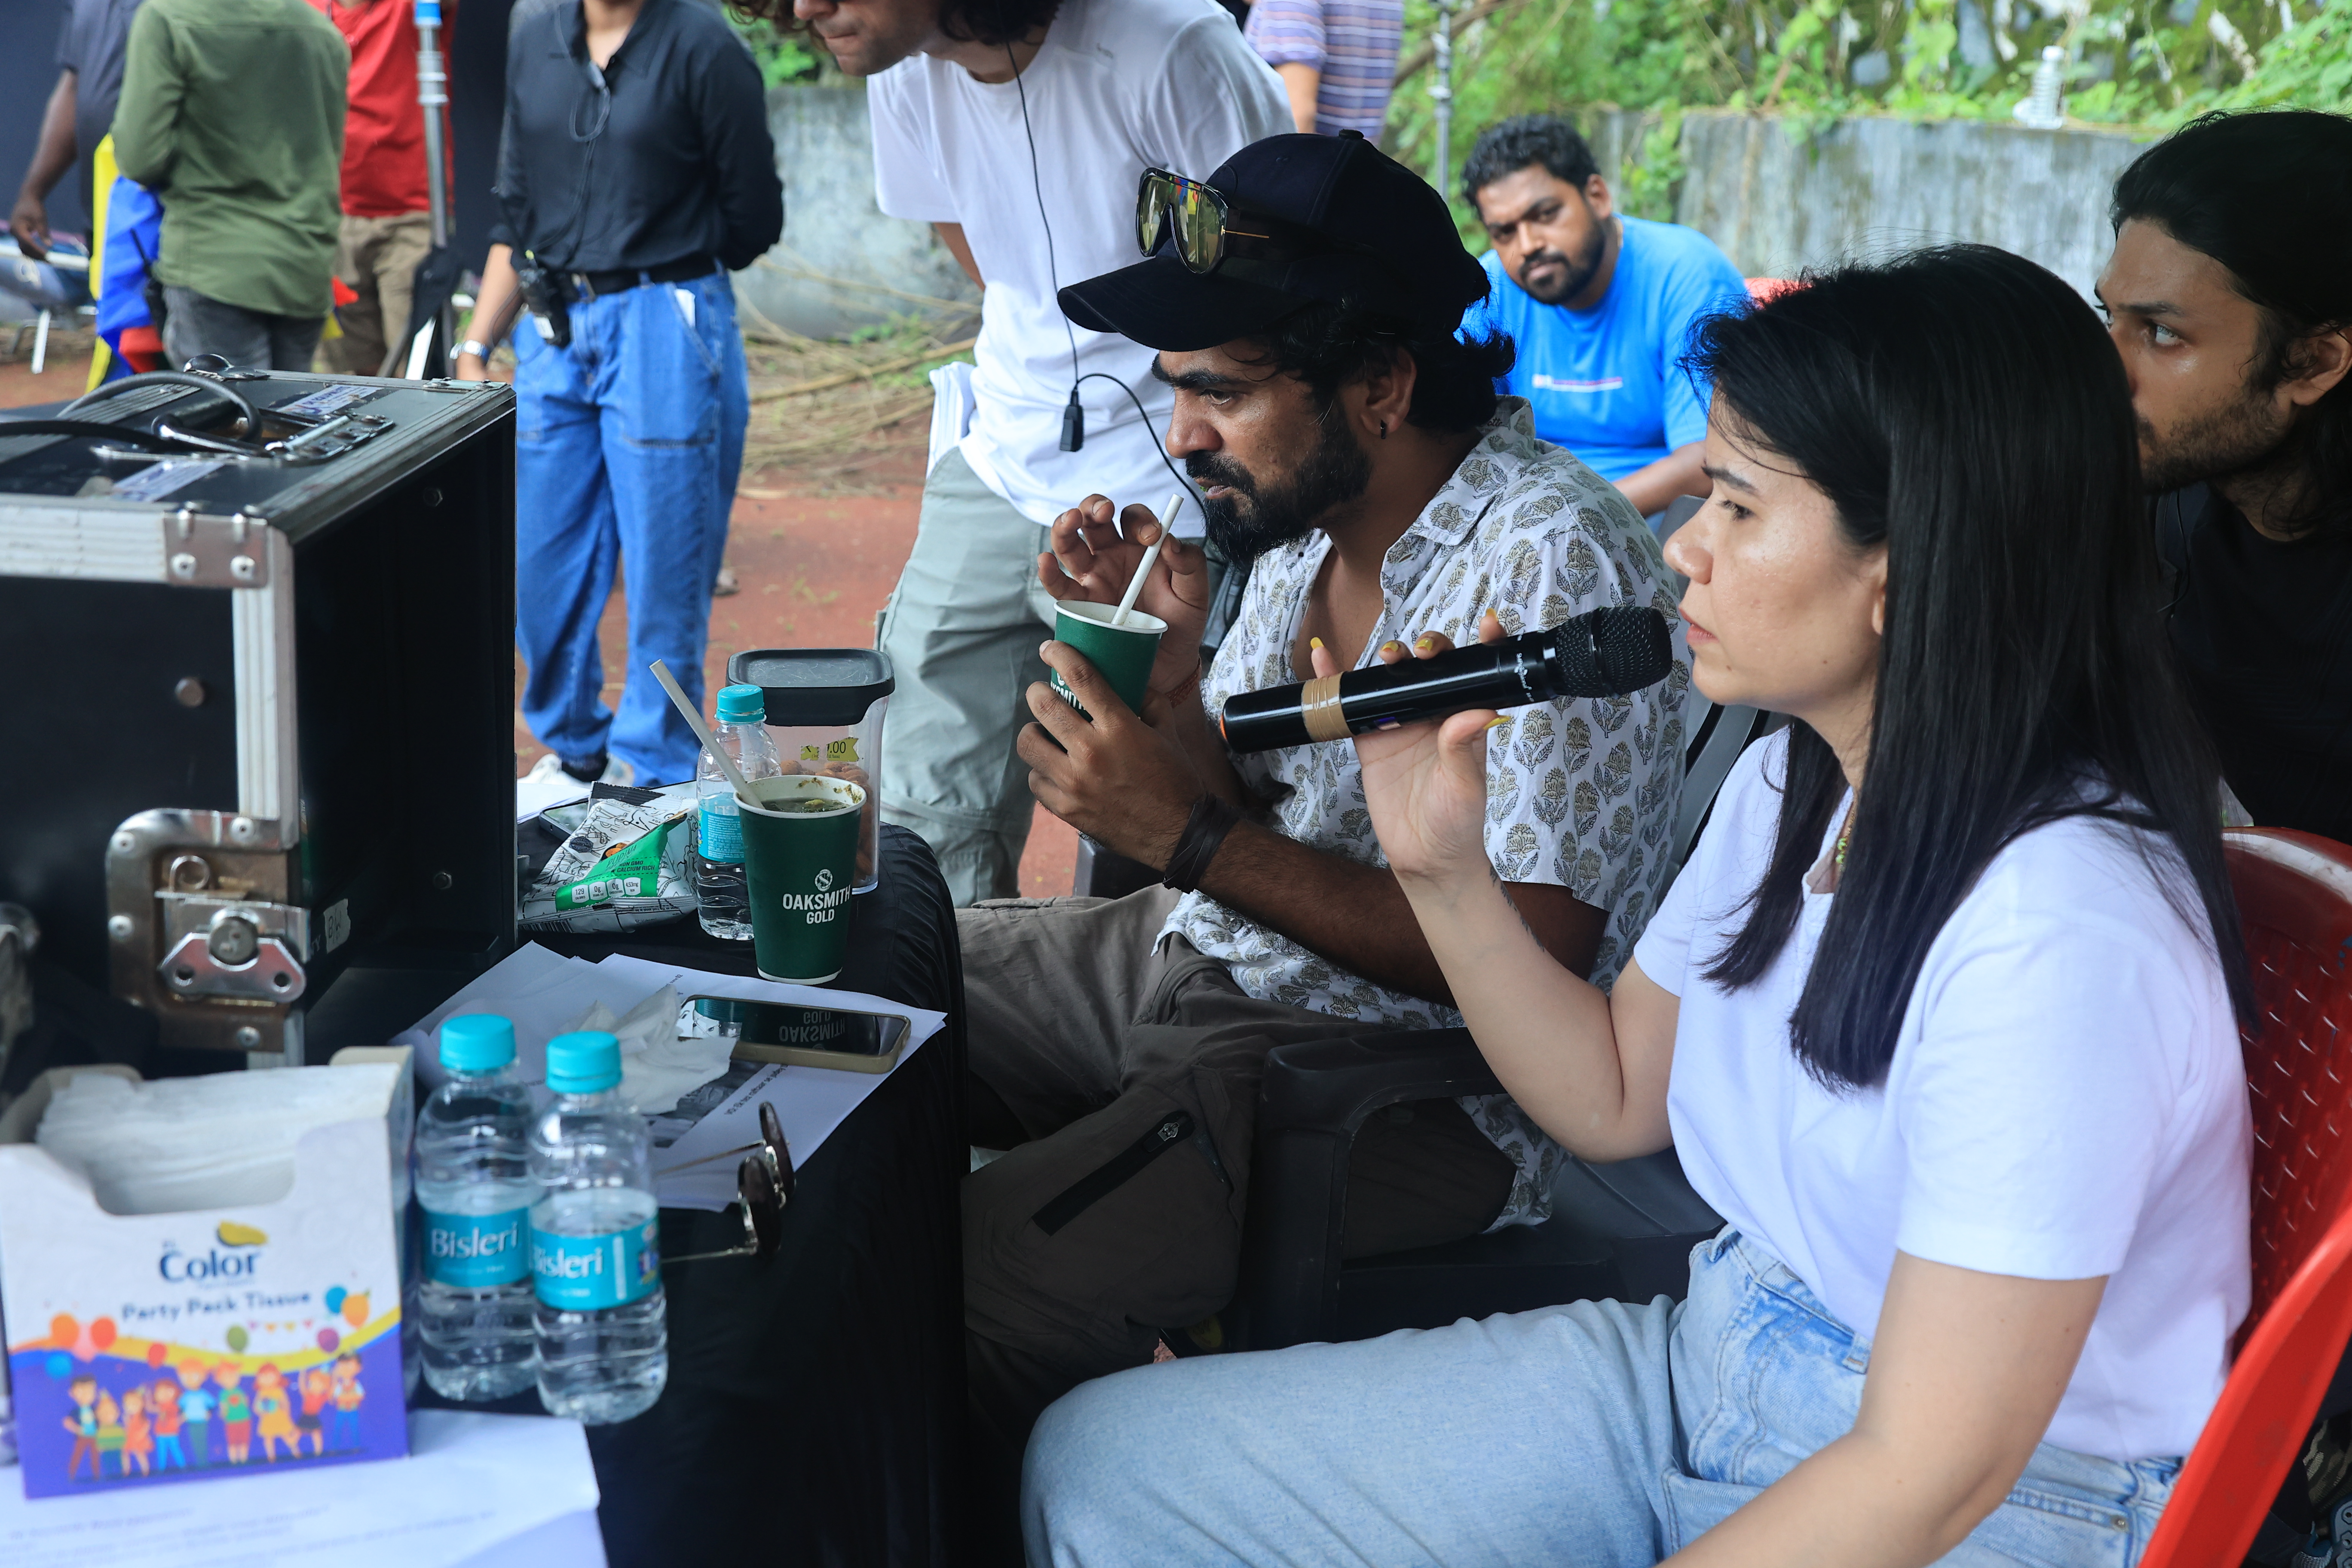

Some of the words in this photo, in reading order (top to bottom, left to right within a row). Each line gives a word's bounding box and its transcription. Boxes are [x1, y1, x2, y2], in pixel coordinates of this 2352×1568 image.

[783, 884, 851, 910] OAKSMITH
[806, 909, 835, 924] GOLD
[431, 1221, 518, 1258] Bisleri
[159, 1249, 261, 1282] Color
[122, 1303, 181, 1322] Party
[188, 1295, 236, 1314] Pack
